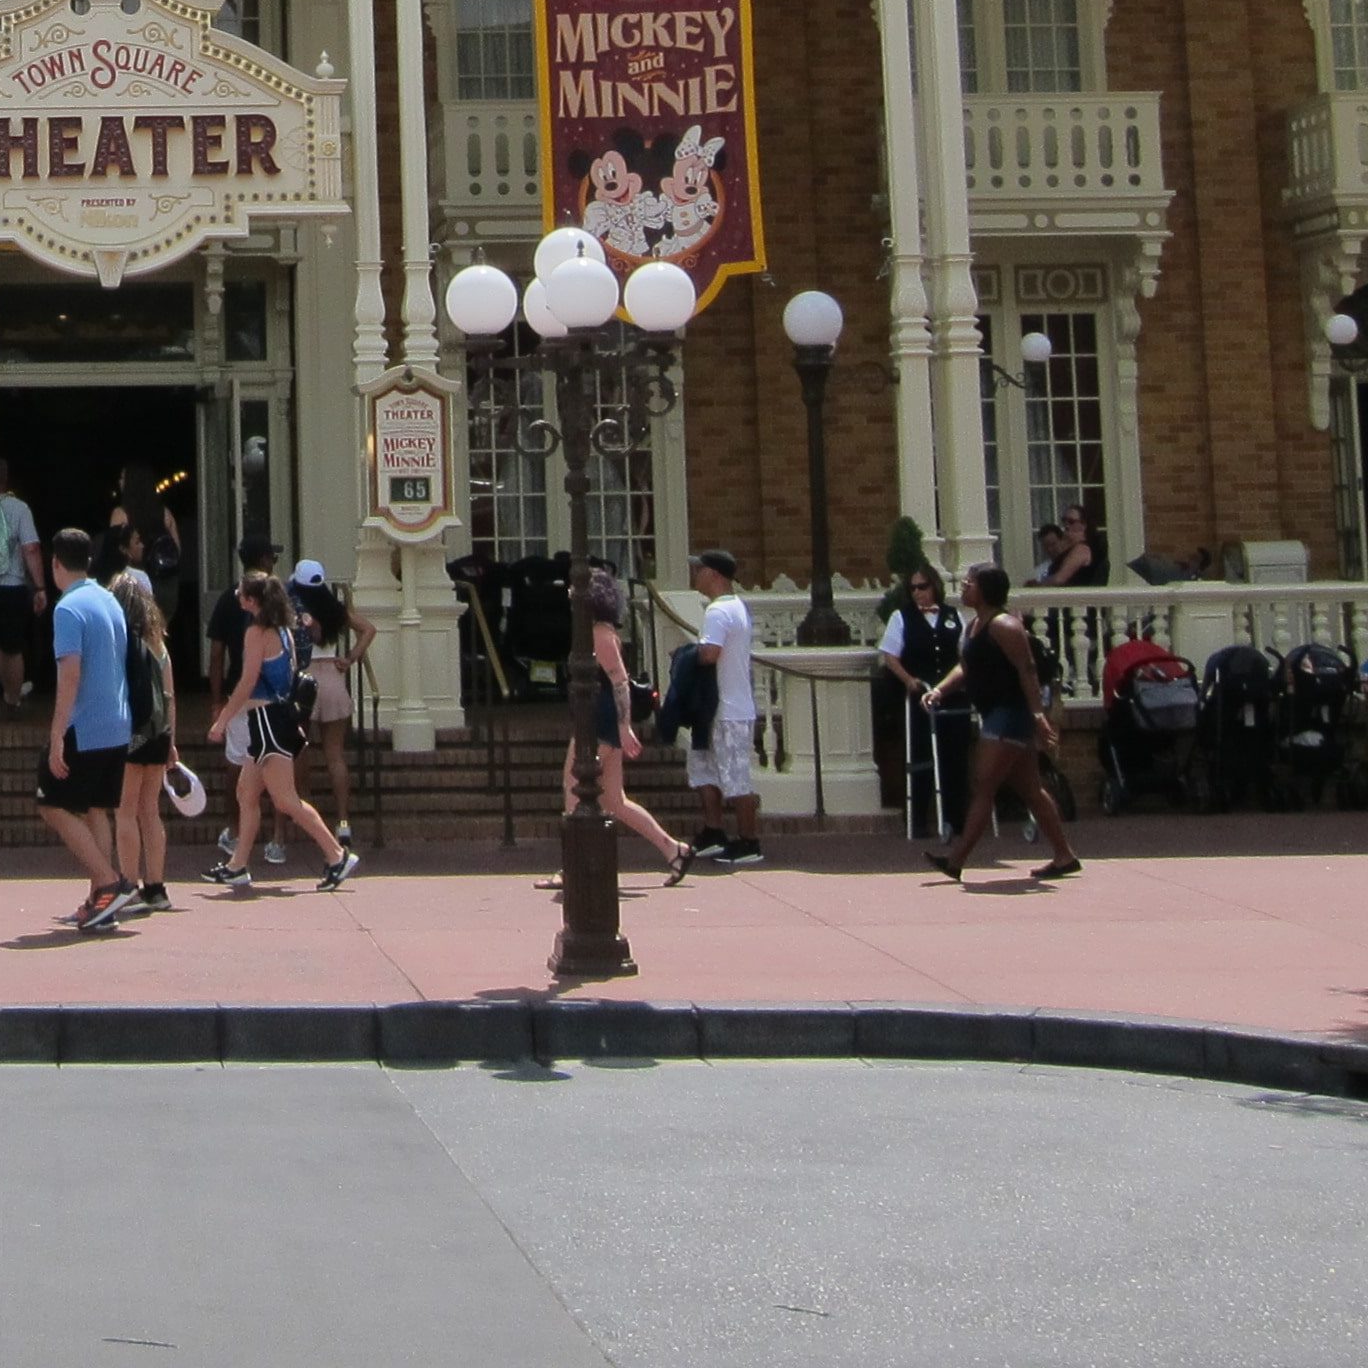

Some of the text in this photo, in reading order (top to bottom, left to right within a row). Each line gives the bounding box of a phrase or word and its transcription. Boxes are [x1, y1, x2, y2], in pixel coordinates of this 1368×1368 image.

[555, 8, 735, 63] MICKEY
[11, 39, 204, 95] TOWN SQUARE
[628, 52, 664, 75] and
[558, 64, 738, 118] MINNIE
[81, 198, 136, 207] PRESENTED BY
[384, 410, 434, 420] THEATER
[384, 438, 436, 452] MICKEY
[384, 454, 436, 467] MINNIE
[404, 481, 426, 498] 65
